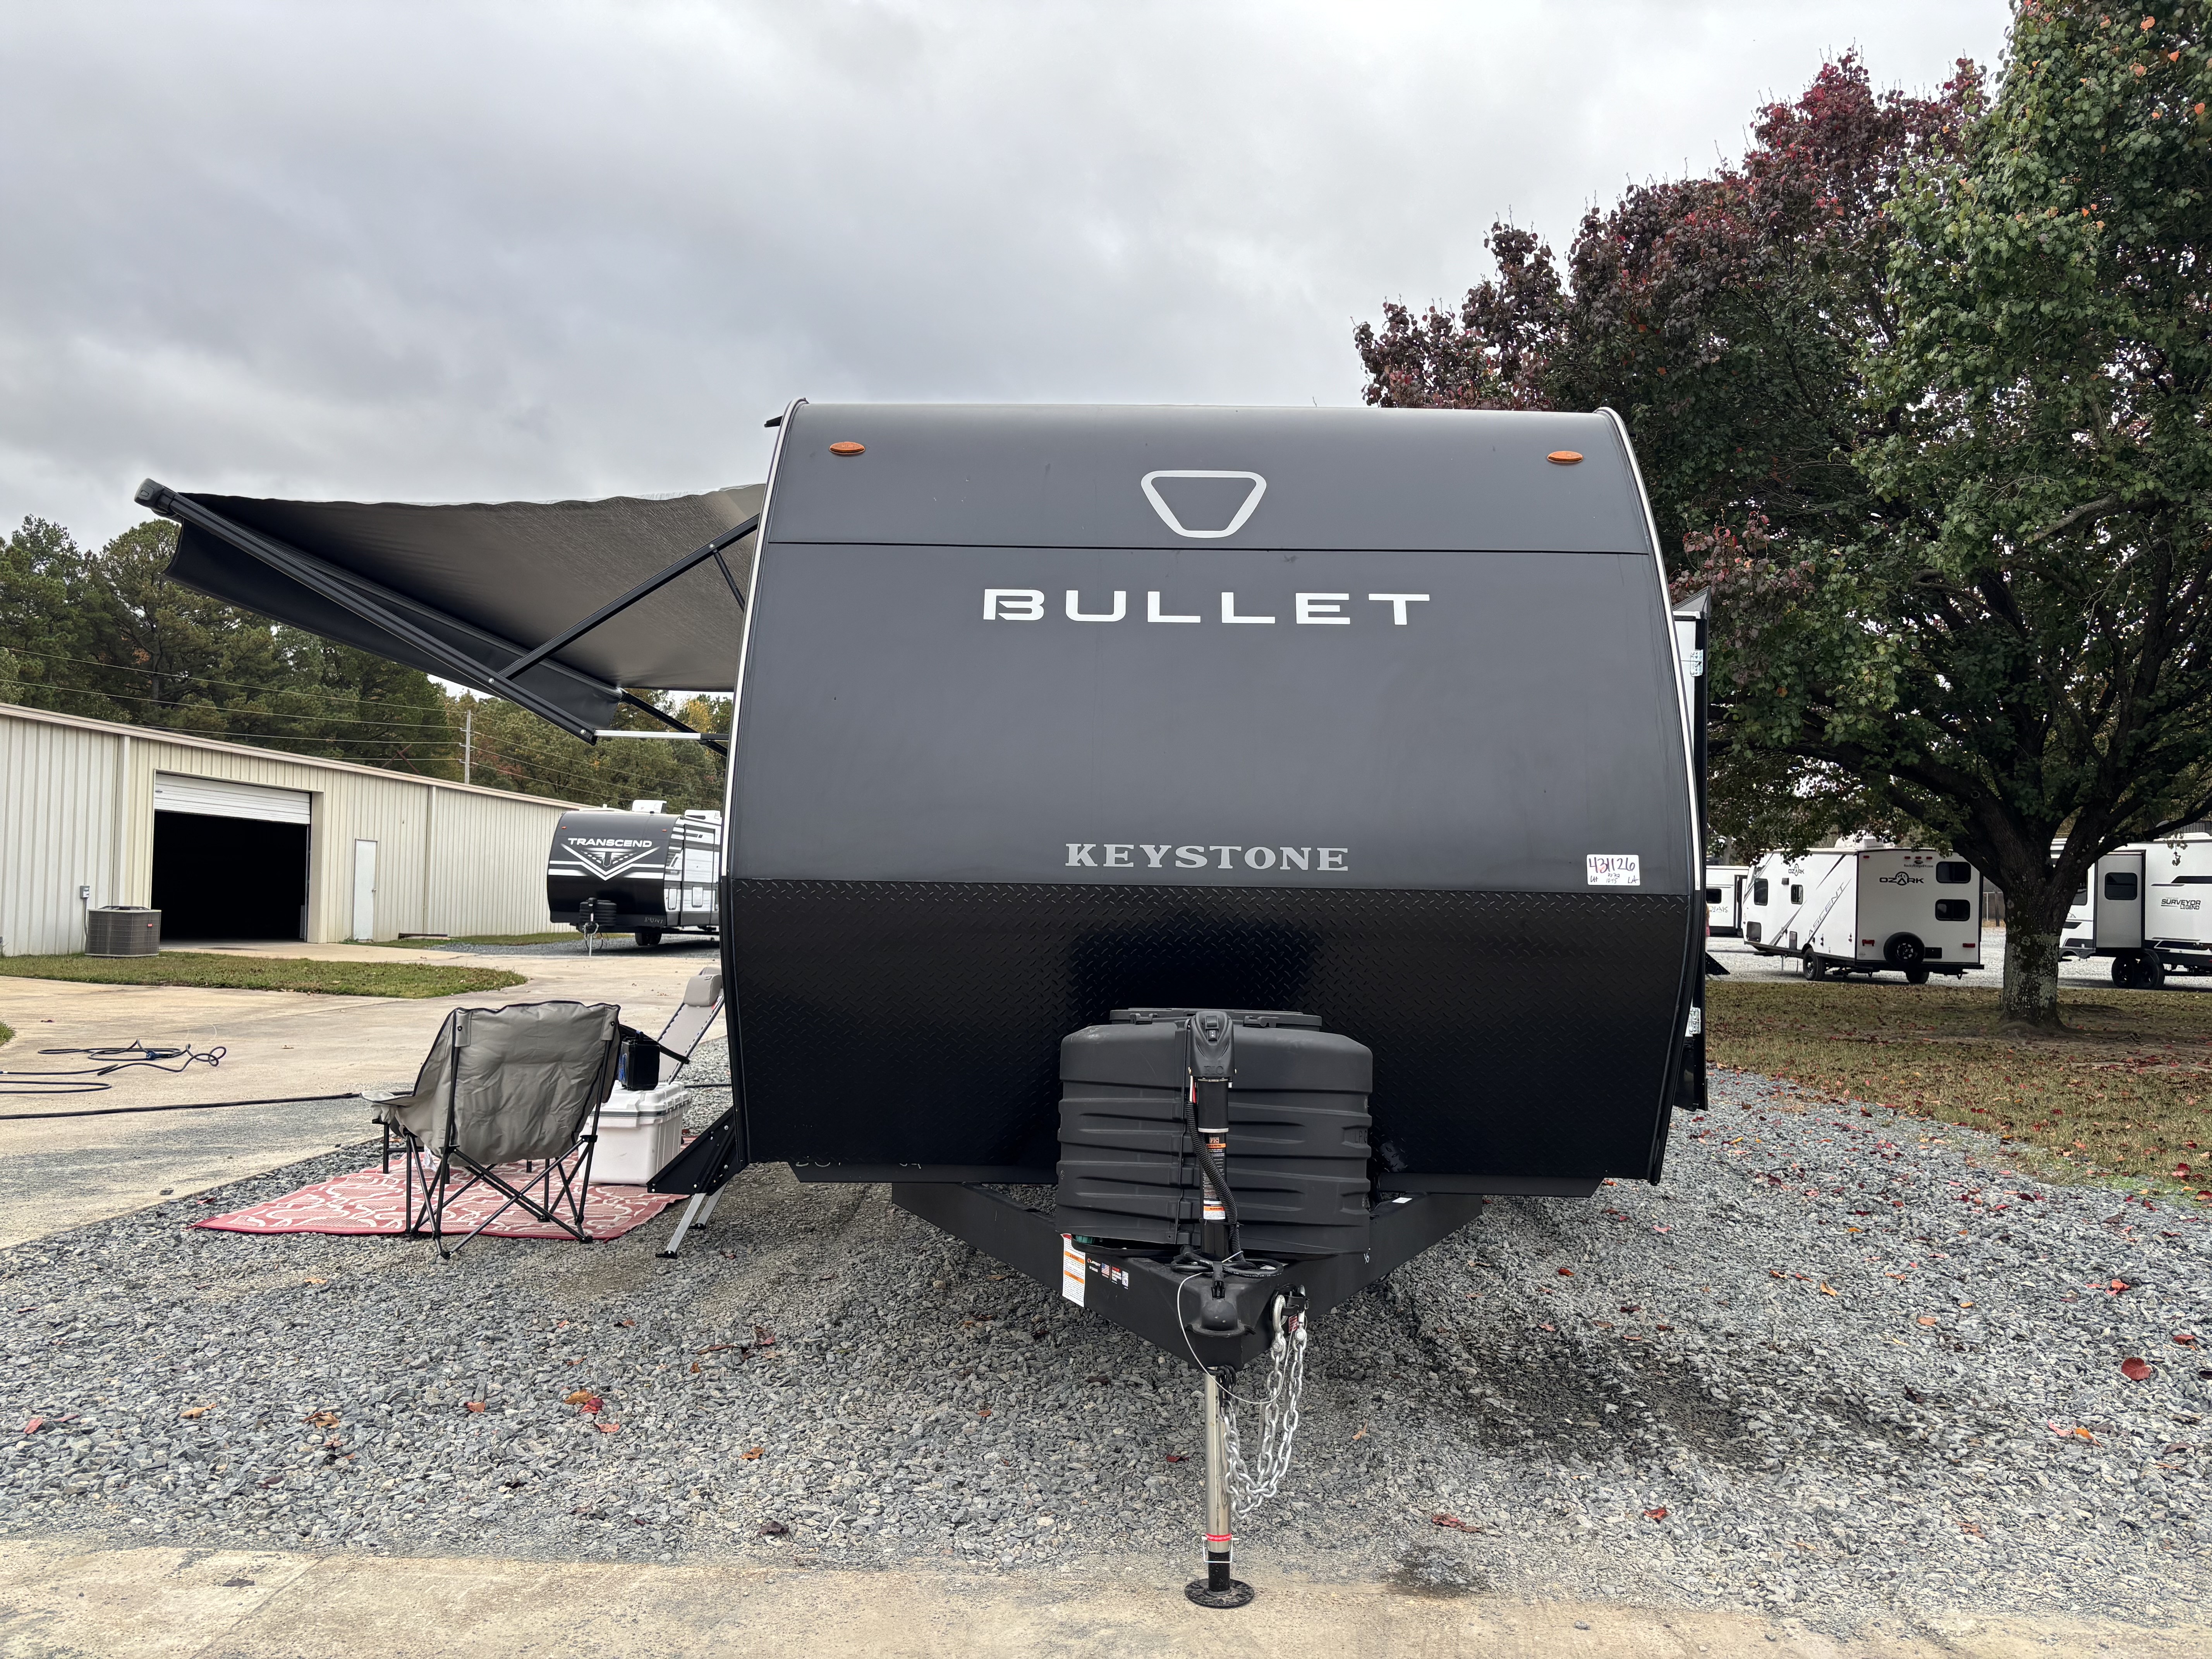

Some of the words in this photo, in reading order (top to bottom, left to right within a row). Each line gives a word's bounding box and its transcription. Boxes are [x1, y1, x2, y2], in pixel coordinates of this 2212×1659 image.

[983, 588, 1430, 625] BULLET
[568, 838, 653, 847] TRANSCEND
[1065, 843, 1348, 871] KEYSTONE
[1589, 857, 1635, 873] 431126
[1879, 873, 1924, 885] OZARK
[1809, 882, 1844, 938] ASCENT
[1203, 1065, 1224, 1075] FIC
